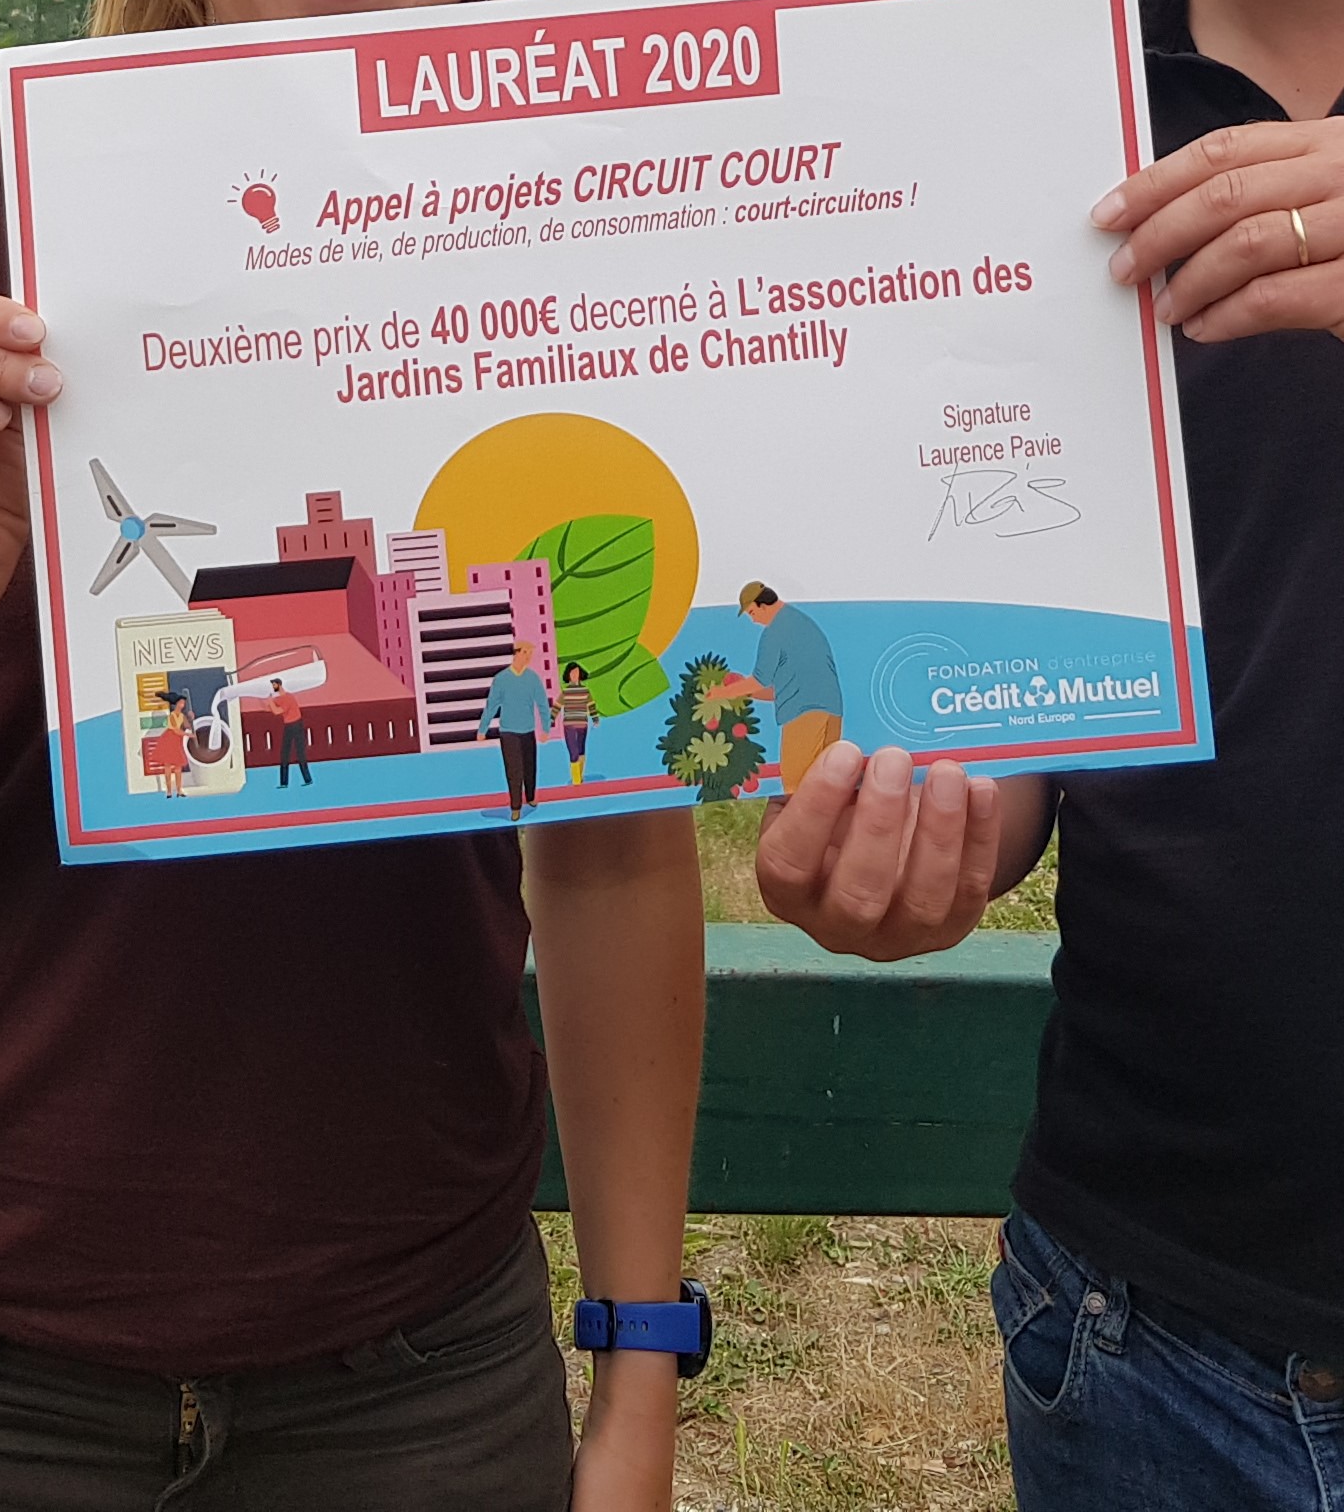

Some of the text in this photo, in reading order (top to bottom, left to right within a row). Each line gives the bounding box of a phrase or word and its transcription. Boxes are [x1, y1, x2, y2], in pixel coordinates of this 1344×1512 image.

[375, 25, 761, 118] LAURÉAT 2020
[316, 141, 842, 235] Appel à projets CIRCUIT COURT
[244, 242, 313, 271] Modes
[319, 238, 344, 264] de
[351, 234, 383, 263] vie,
[391, 231, 417, 257] de
[421, 222, 532, 261] production,
[539, 217, 565, 243] de
[570, 203, 716, 240] consommation
[734, 189, 904, 224] court-circuitons
[142, 324, 303, 372] Deuxième
[313, 314, 372, 367] prix
[381, 310, 420, 351] de
[430, 304, 470, 345] 40
[480, 295, 560, 342] 000€
[569, 282, 698, 333] decerné
[708, 279, 728, 320] à
[972, 255, 1033, 296] des
[336, 318, 848, 404] Jardins Familiaux de Chantilly
[943, 402, 1031, 433] Signature
[918, 433, 1062, 468] Laurence Pavie
[132, 633, 225, 667] NEWS
[927, 658, 1040, 681] FONDATION
[930, 671, 1161, 715] Crédit Mutuel
[1008, 711, 1076, 726] Nord Europe
